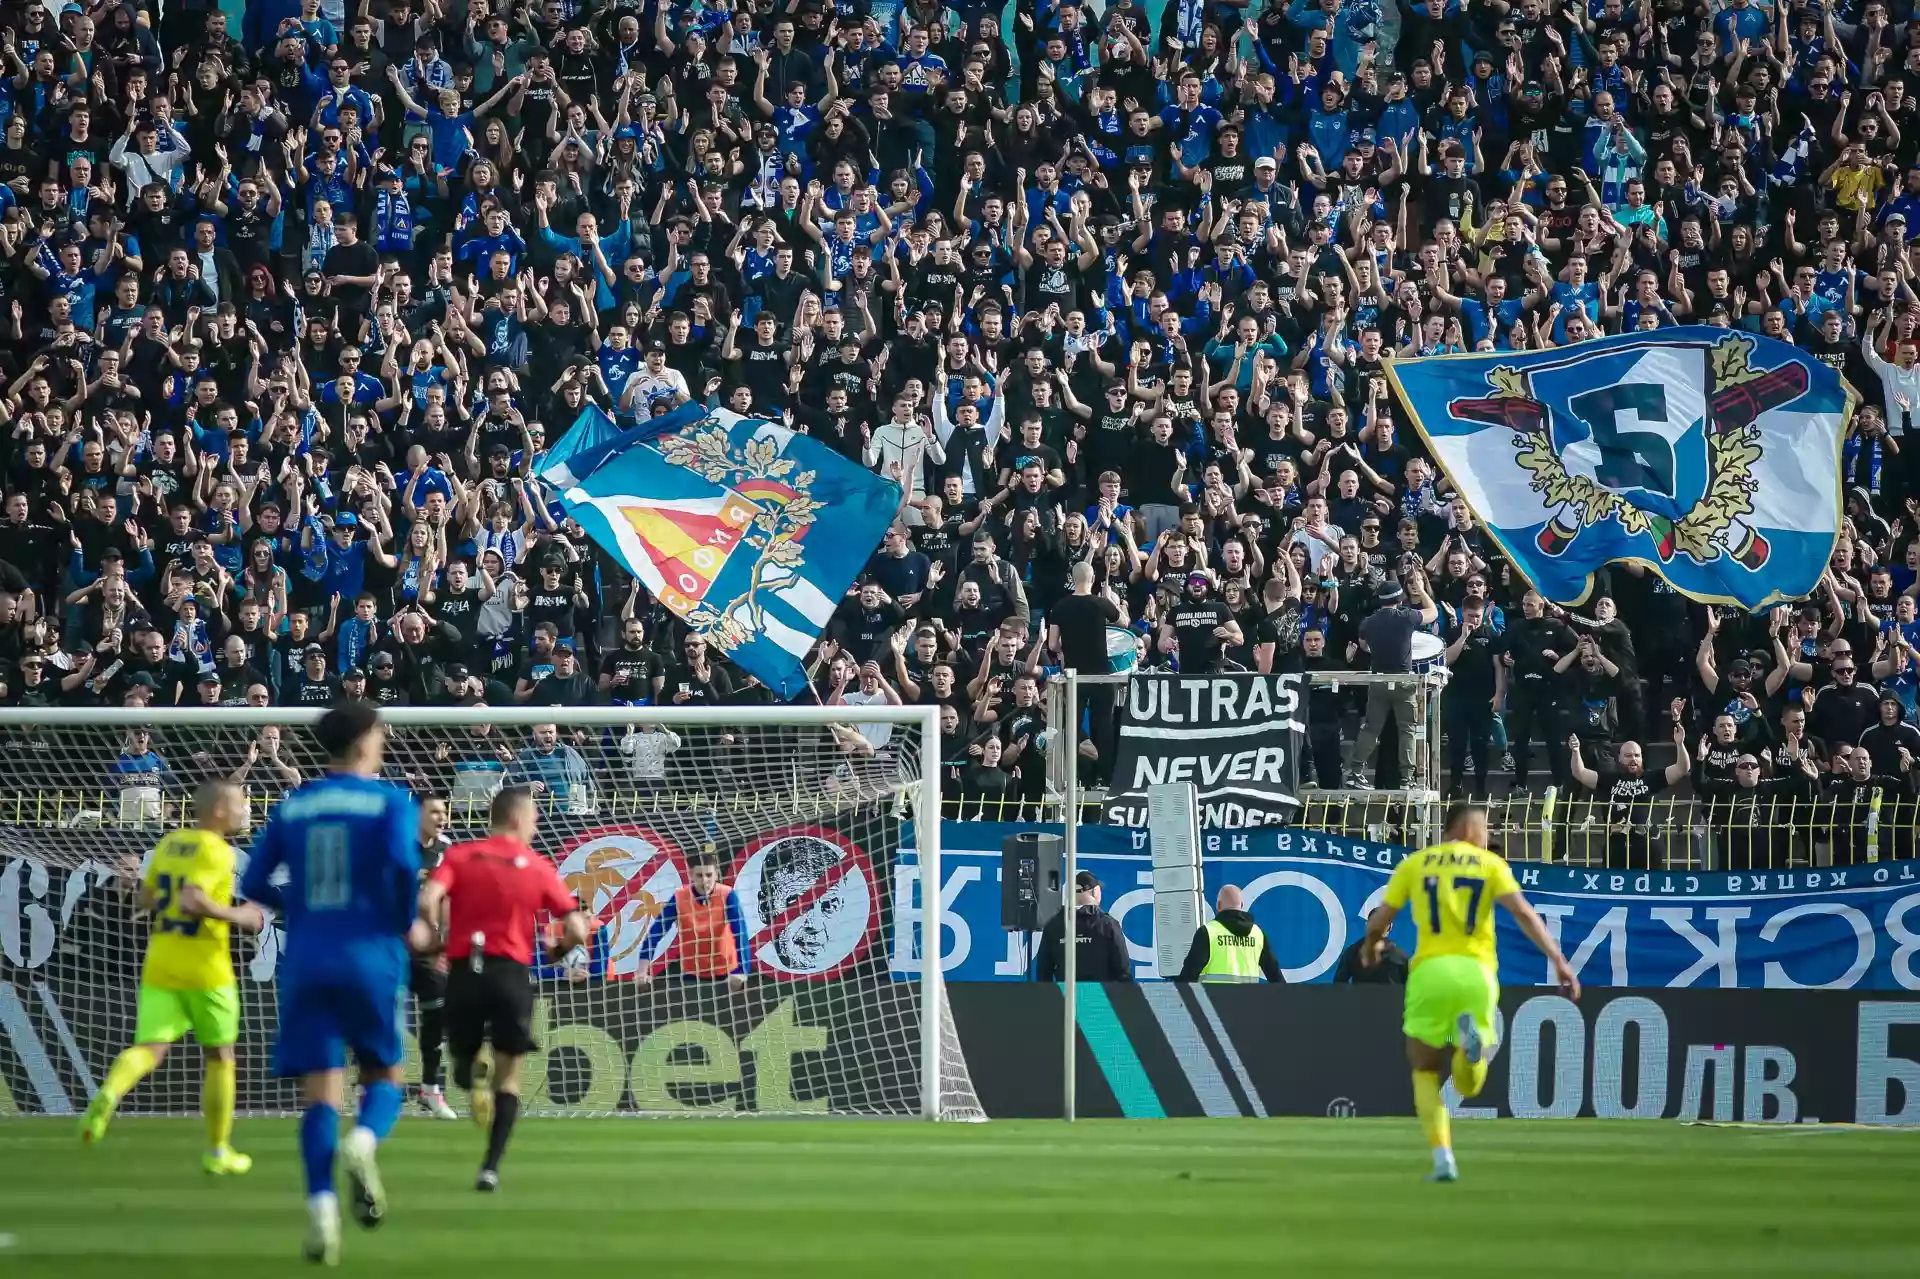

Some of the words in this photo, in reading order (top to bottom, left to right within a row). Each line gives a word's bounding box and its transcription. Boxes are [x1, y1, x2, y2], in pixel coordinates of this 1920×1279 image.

[901, 77, 928, 86] adida
[1129, 672, 1306, 723] ULTRAS
[1133, 746, 1286, 790] NEVER
[1131, 830, 1249, 852] над
[1278, 832, 1408, 866] рачка
[1568, 869, 1700, 893] страх,
[1727, 870, 1848, 893] капка
[1423, 876, 1484, 936] 17
[1217, 933, 1257, 948] STEWARD
